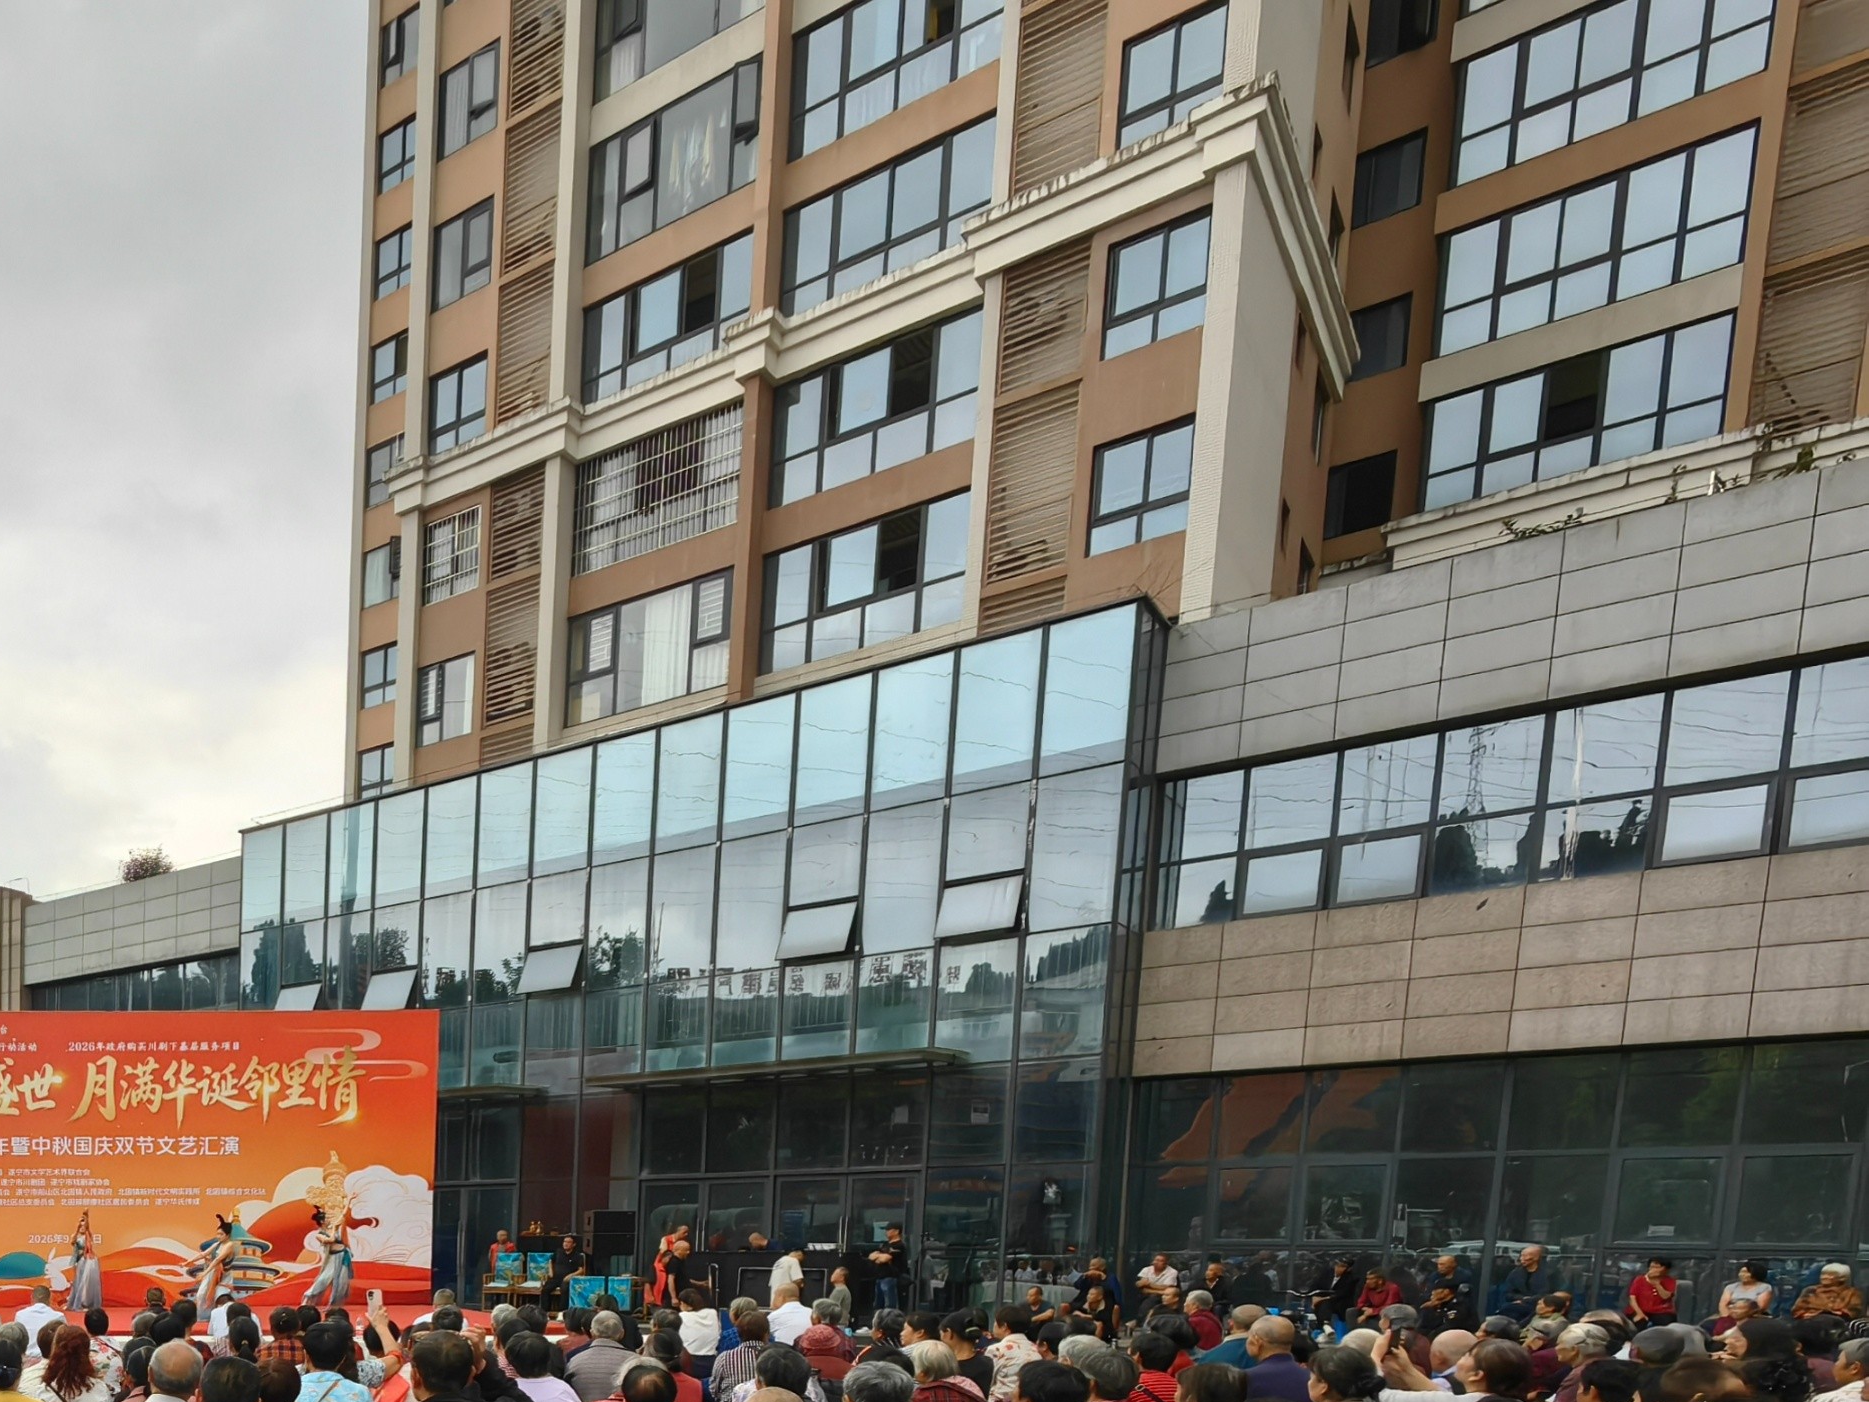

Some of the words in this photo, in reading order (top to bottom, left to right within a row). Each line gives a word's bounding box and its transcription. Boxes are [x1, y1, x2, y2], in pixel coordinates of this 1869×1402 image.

[67, 1045, 366, 1130] 月满华诞邻里情
